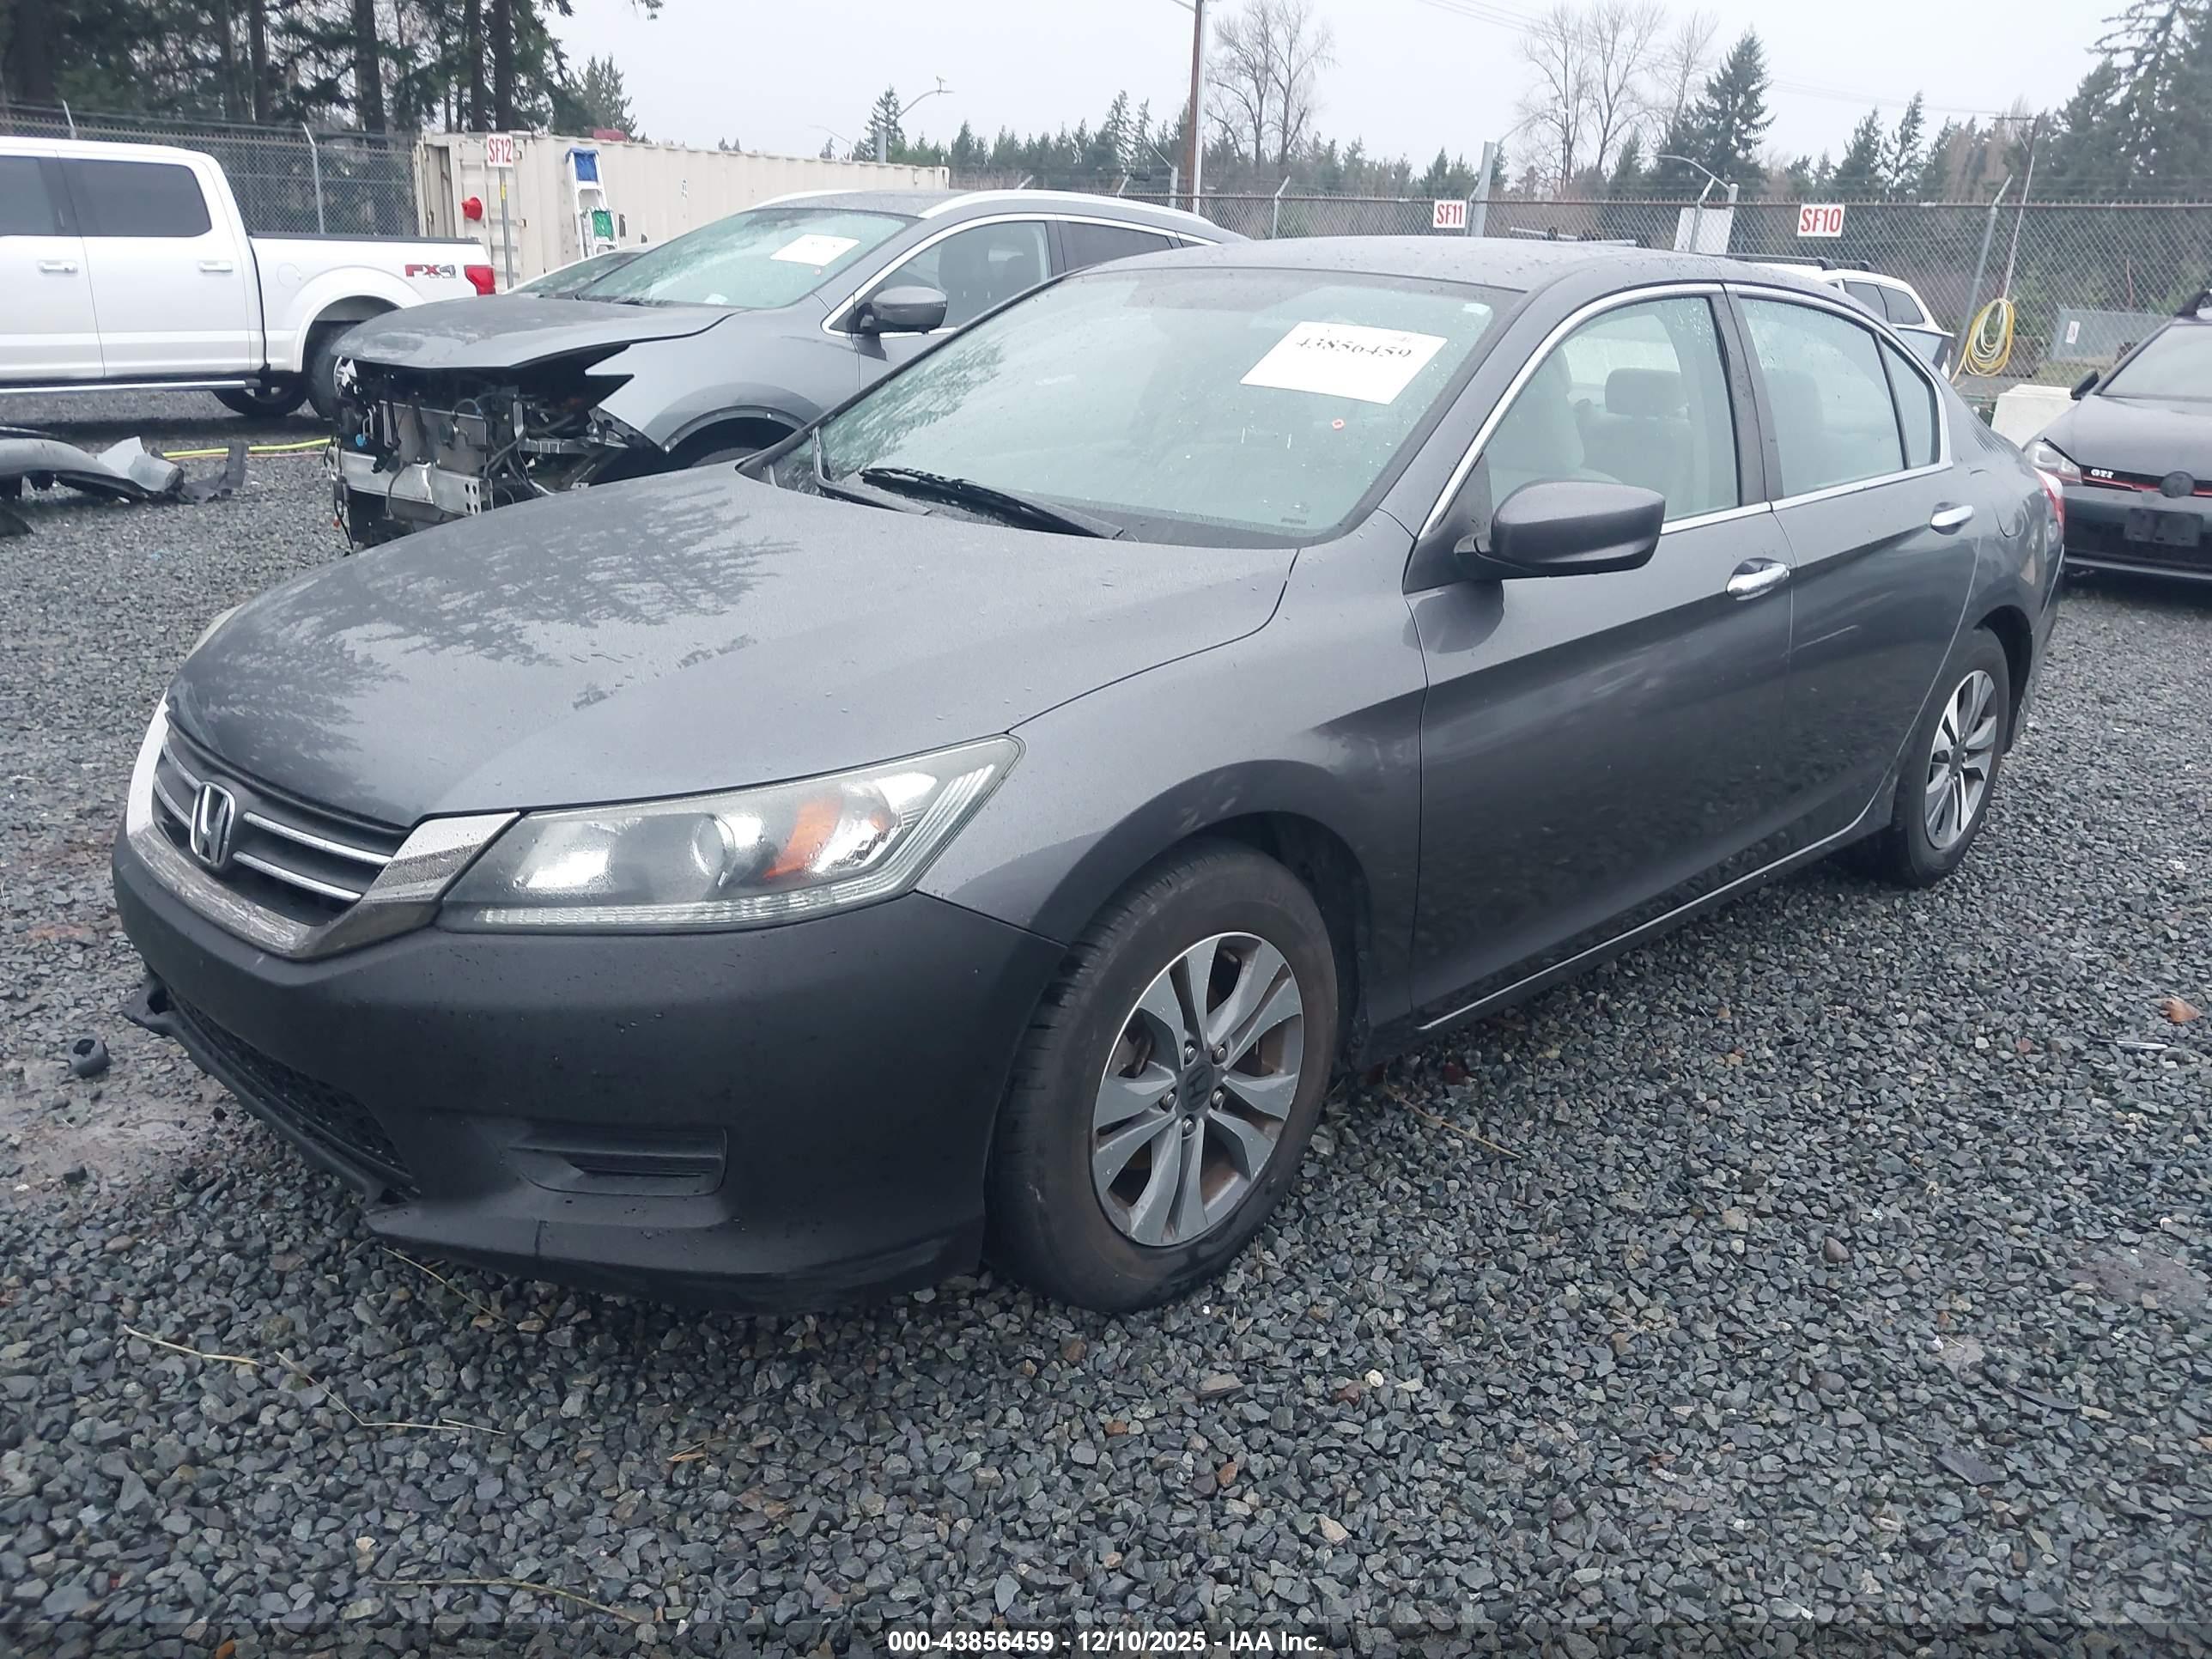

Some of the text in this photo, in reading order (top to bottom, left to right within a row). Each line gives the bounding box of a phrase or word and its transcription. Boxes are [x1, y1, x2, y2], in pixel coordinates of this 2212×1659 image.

[489, 137, 512, 163] SF12
[1436, 204, 1463, 225] SF11
[1800, 208, 1842, 233] SF10
[404, 264, 456, 277] FX4
